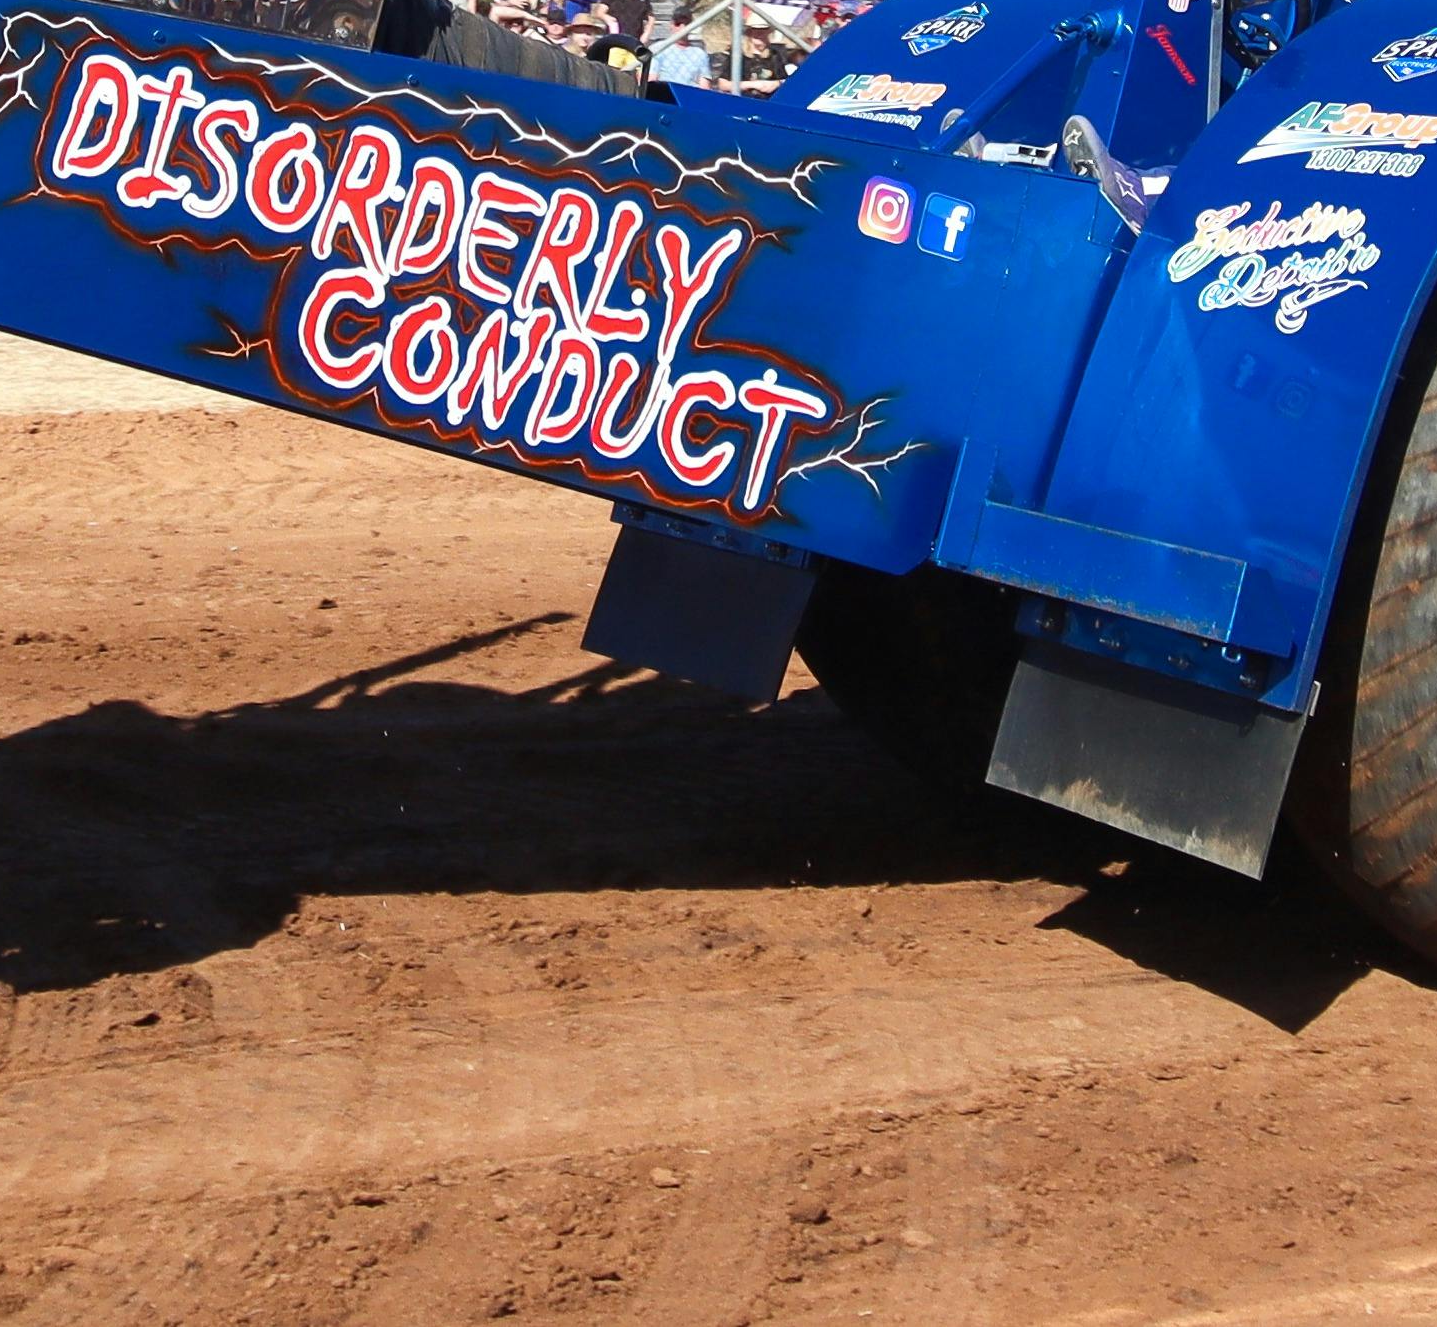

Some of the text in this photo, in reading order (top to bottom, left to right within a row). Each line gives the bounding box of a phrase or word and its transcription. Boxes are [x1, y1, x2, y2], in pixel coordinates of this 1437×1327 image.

[909, 20, 981, 39] SPARK
[52, 53, 744, 366] DISORDERLY
[297, 268, 826, 511] CONDUCT
